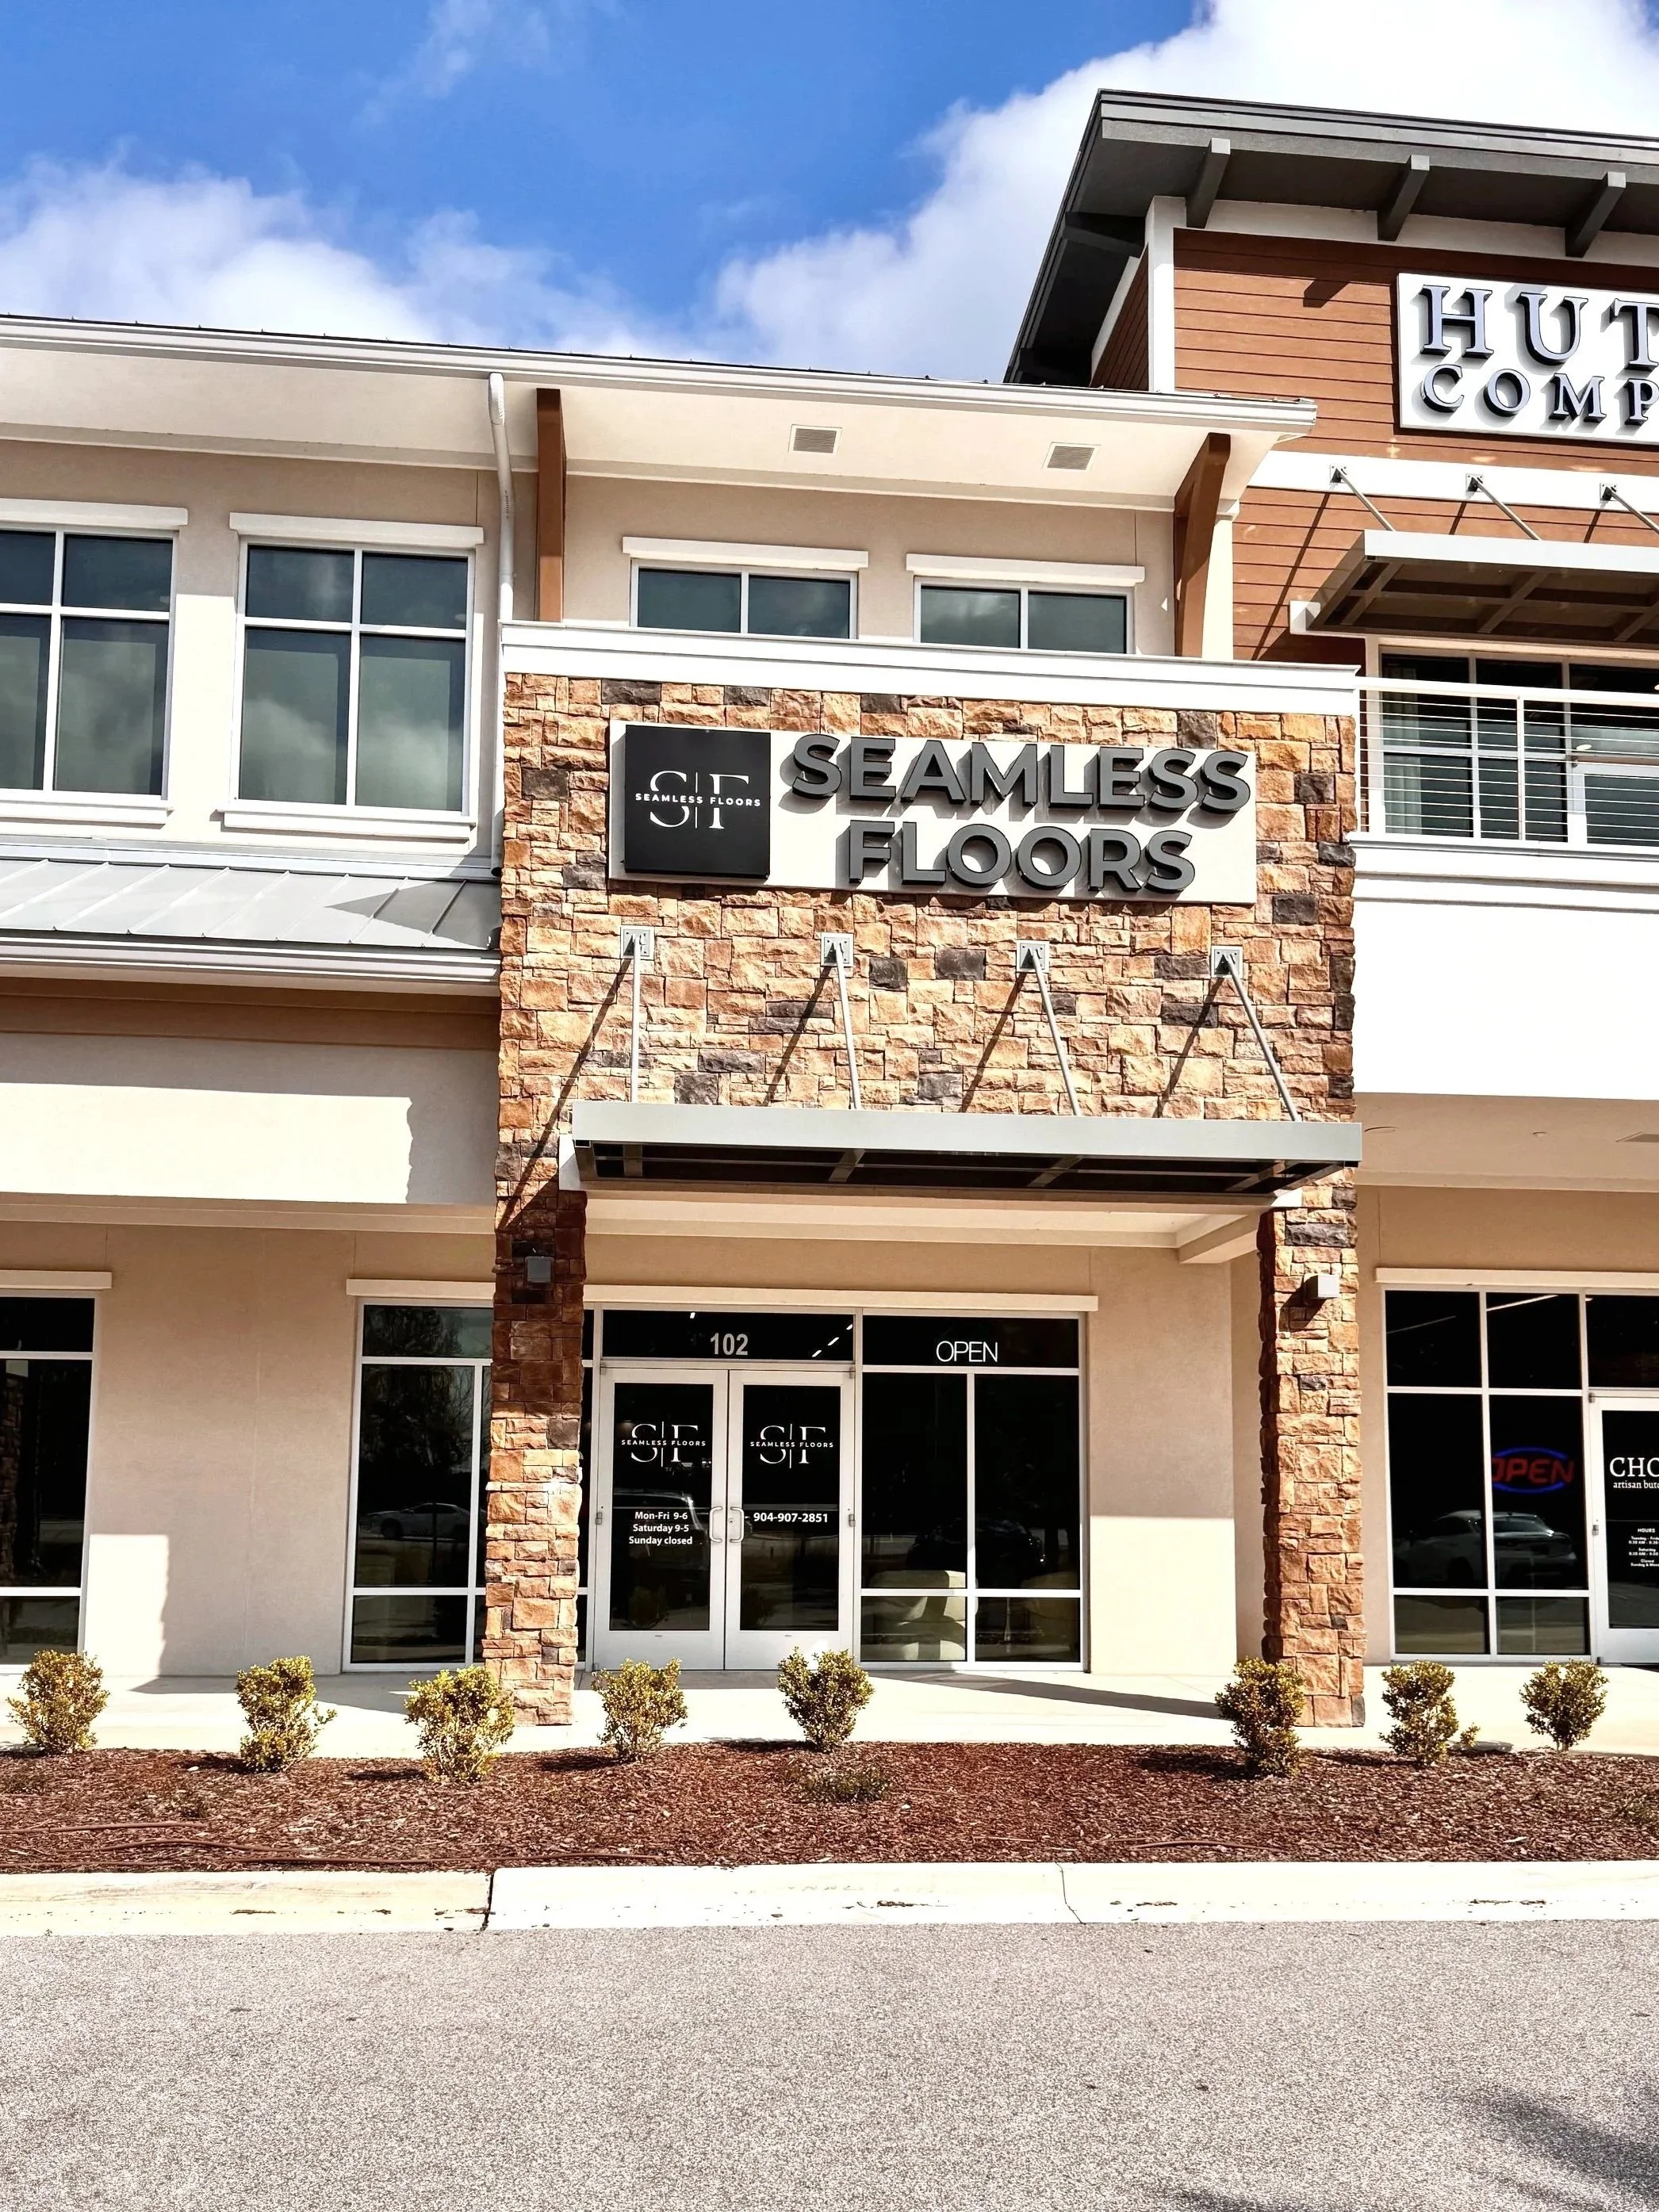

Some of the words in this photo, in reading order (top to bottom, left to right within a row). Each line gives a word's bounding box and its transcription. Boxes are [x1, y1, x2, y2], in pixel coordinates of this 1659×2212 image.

[1419, 283, 1659, 369] HUT
[1420, 363, 1659, 426] COMP
[791, 733, 1251, 814] SEAMLESS
[635, 793, 703, 804] SEAMLESS
[710, 797, 761, 807] FLOORS
[849, 819, 1196, 894] FLOORS
[710, 1333, 749, 1357] 102
[936, 1340, 998, 1363] OPEN
[1613, 1479, 1642, 1489] artisan
[634, 1511, 670, 1520] Mon-Fri
[753, 1512, 829, 1523] 904-907-2851
[632, 1524, 673, 1534] Saturday
[674, 1524, 689, 1533] 9-5
[628, 1536, 663, 1546] Sunday
[664, 1536, 693, 1545] closed
